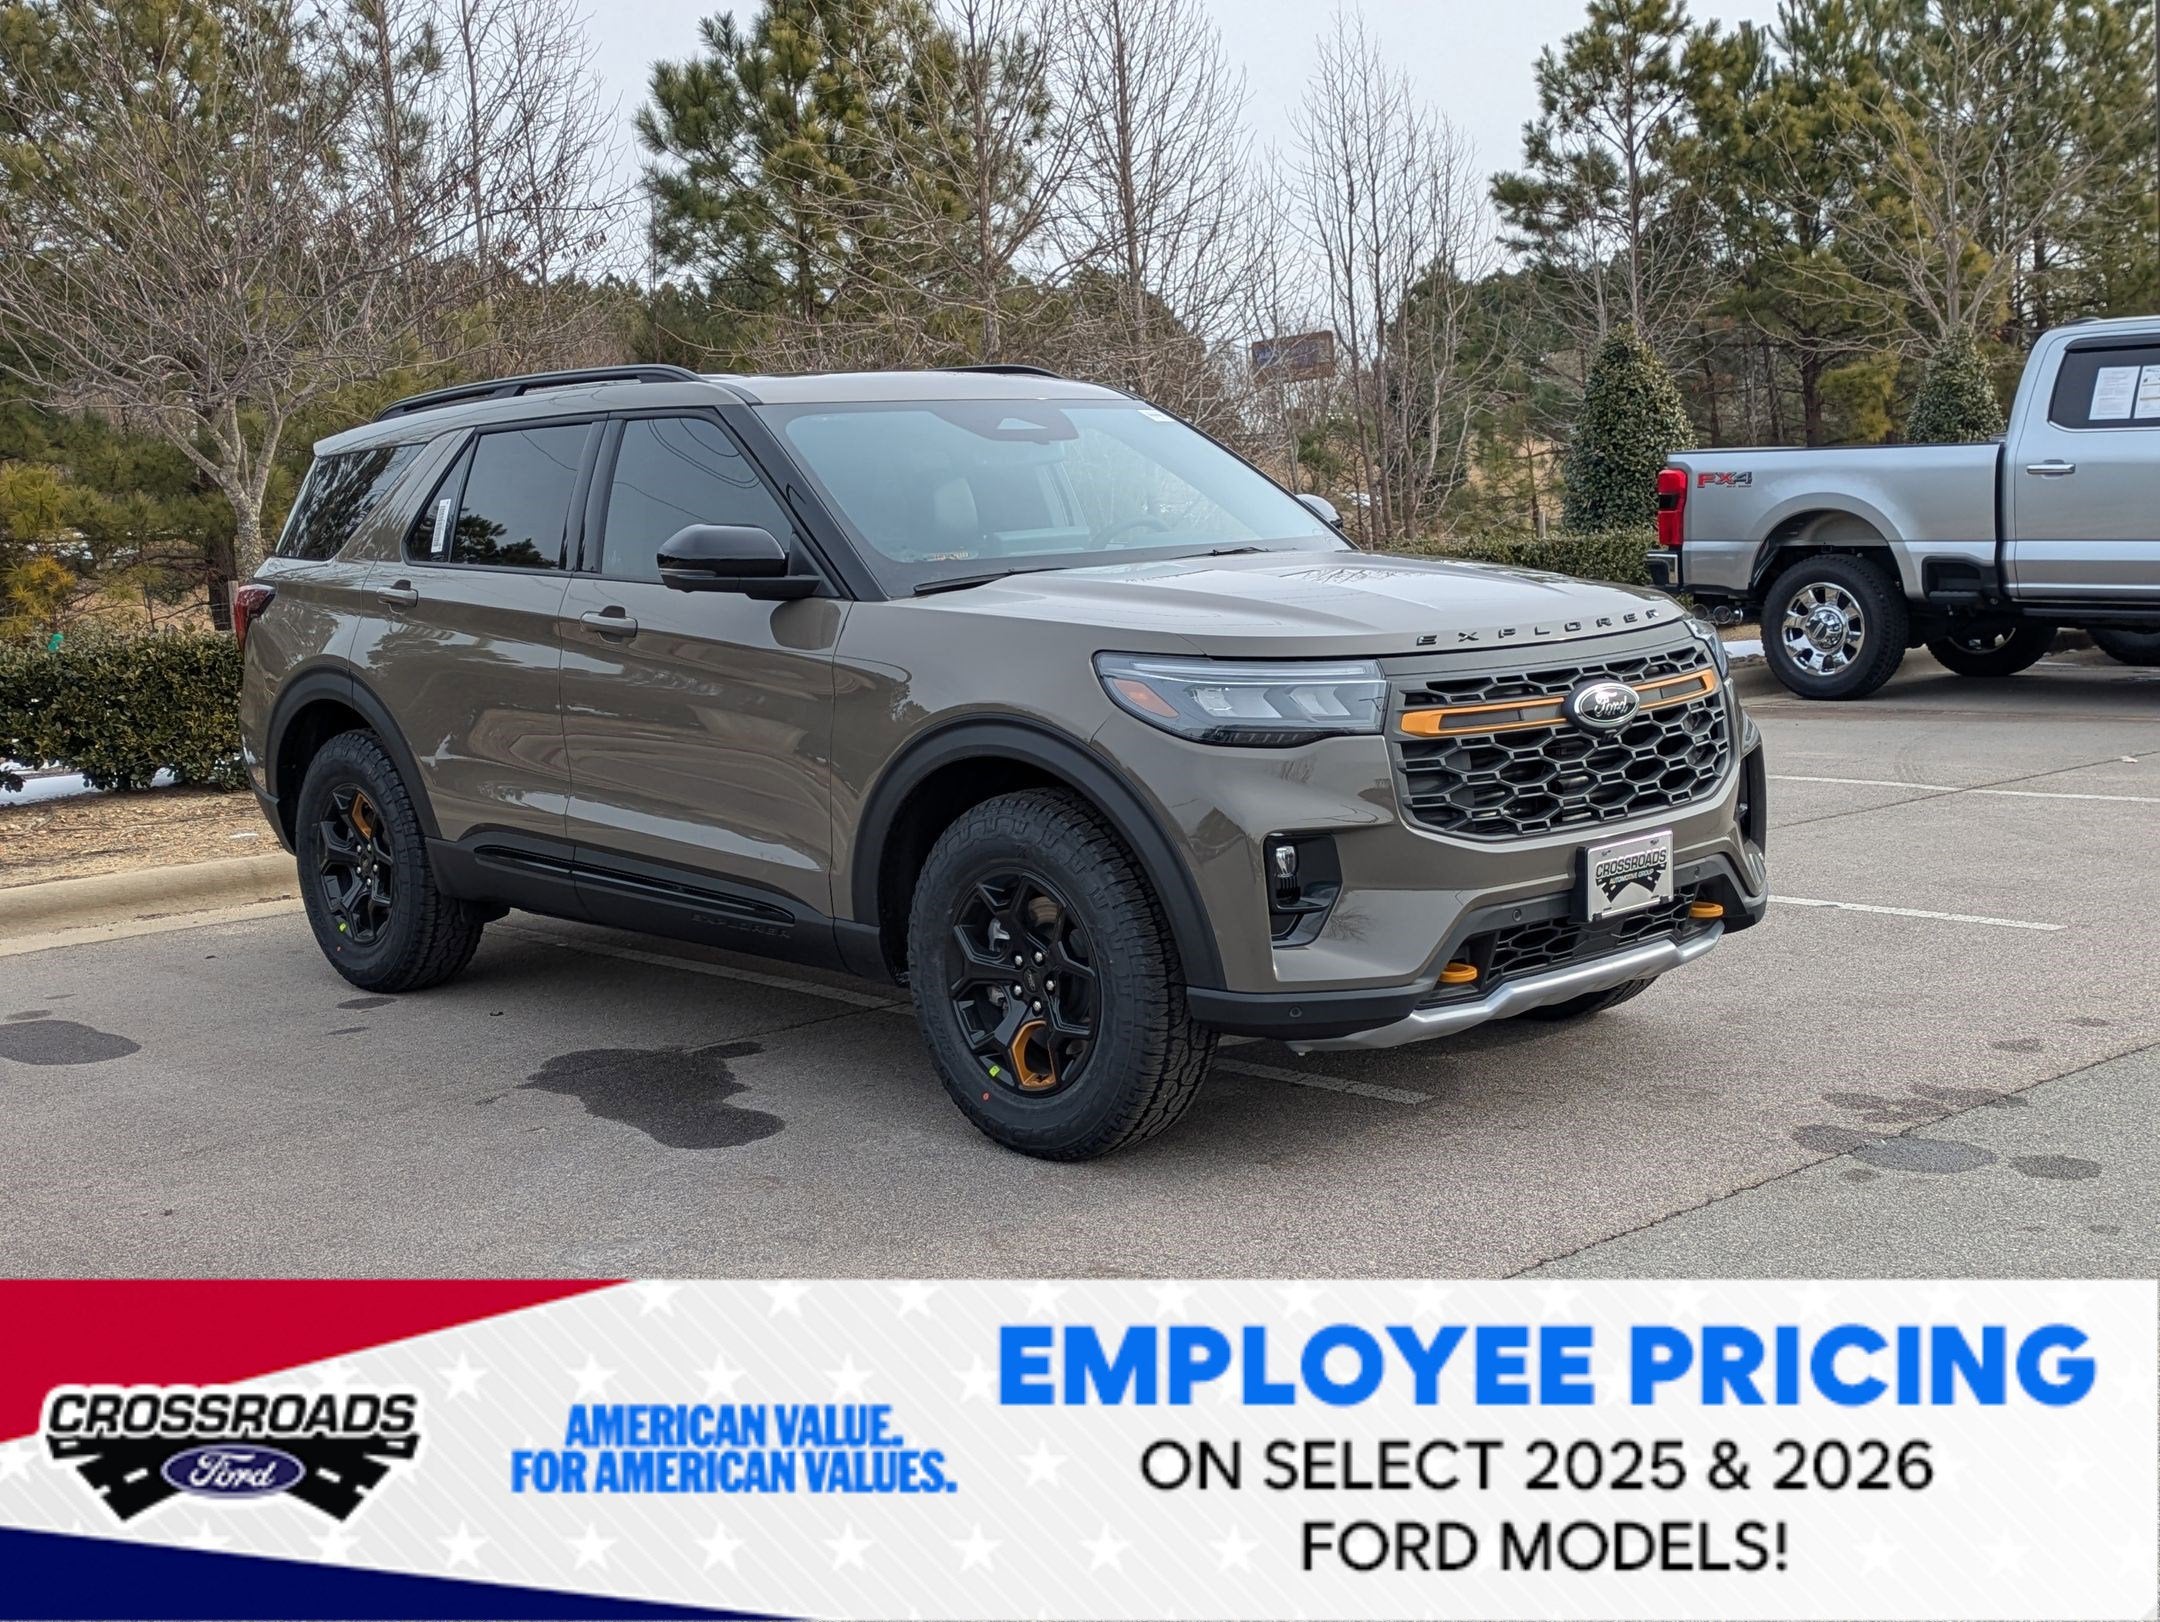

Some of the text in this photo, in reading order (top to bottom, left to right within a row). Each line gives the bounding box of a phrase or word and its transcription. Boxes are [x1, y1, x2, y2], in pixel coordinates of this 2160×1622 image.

[1697, 471, 1753, 488] FX4
[1416, 609, 1660, 646] EXPLORER
[1593, 689, 1629, 718] Ford
[1595, 849, 1667, 878] CROSSROADS
[1637, 868, 1654, 879] GROUP
